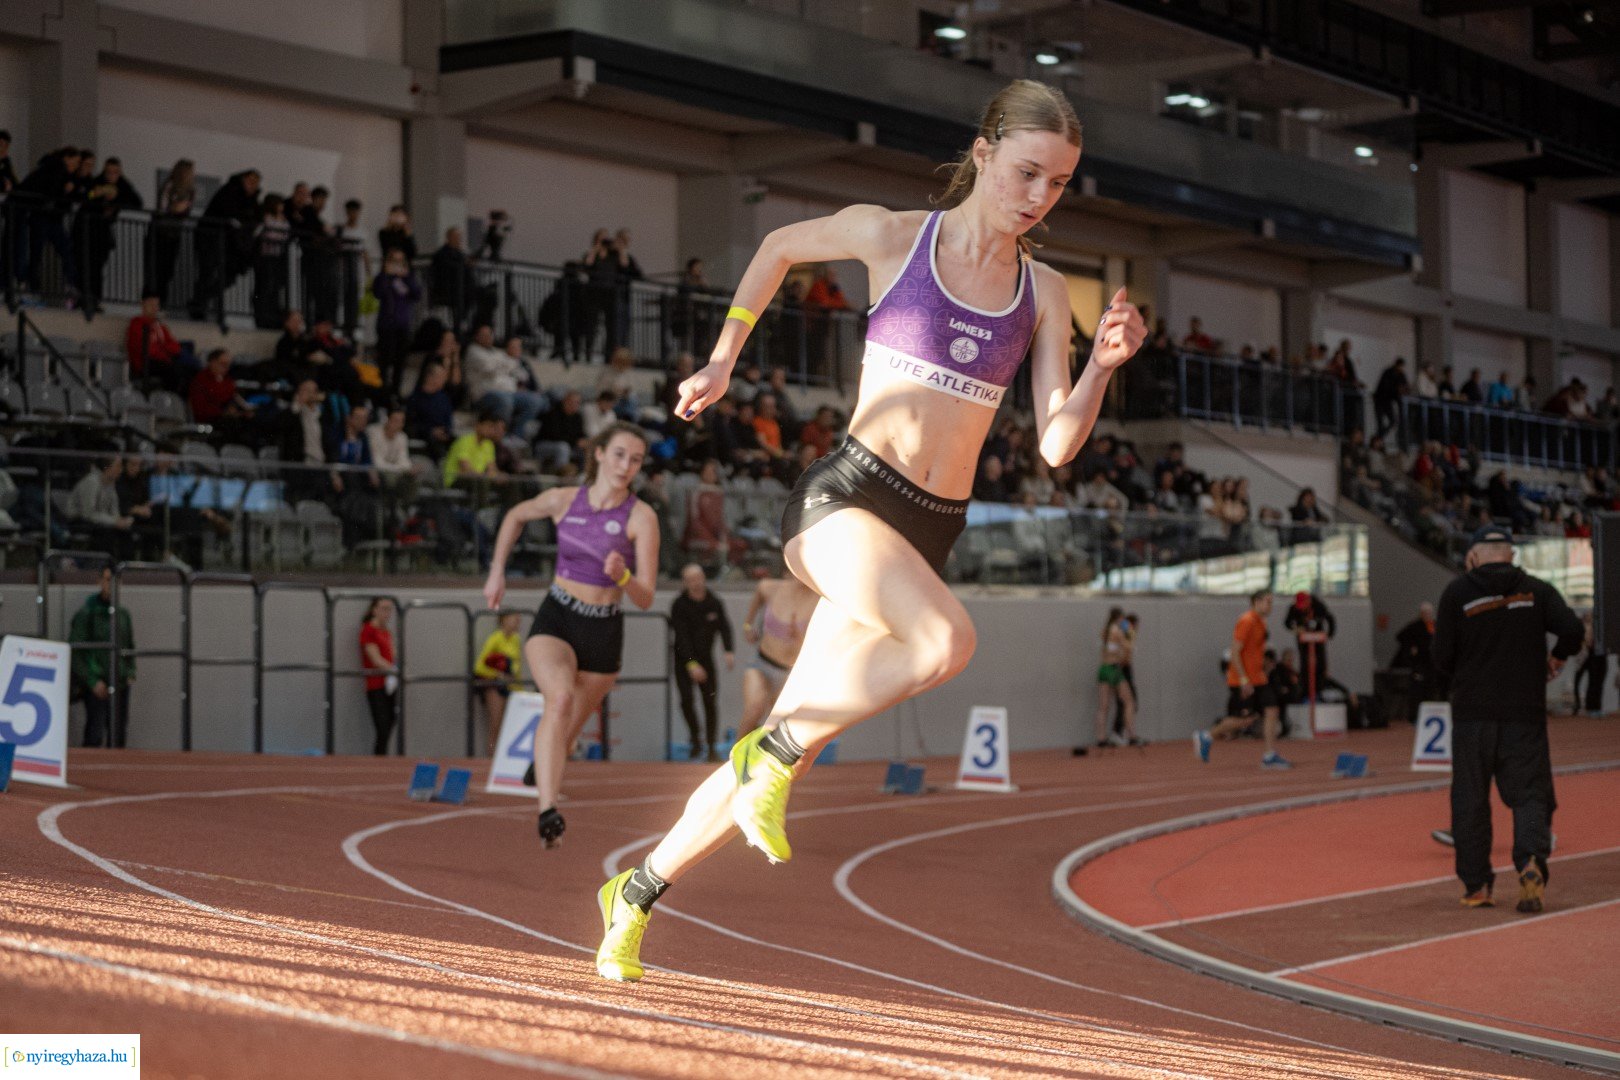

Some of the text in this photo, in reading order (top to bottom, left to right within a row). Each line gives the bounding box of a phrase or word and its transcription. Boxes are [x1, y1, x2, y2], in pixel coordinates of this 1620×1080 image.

[889, 356, 998, 402] UTE ATLÉTIKA
[855, 451, 953, 514] ARMOUR ARMOUR
[571, 600, 610, 618] NIKE
[0, 663, 56, 747] 5
[507, 713, 543, 762] 4
[973, 723, 998, 770] 3
[1424, 716, 1445, 753] 2
